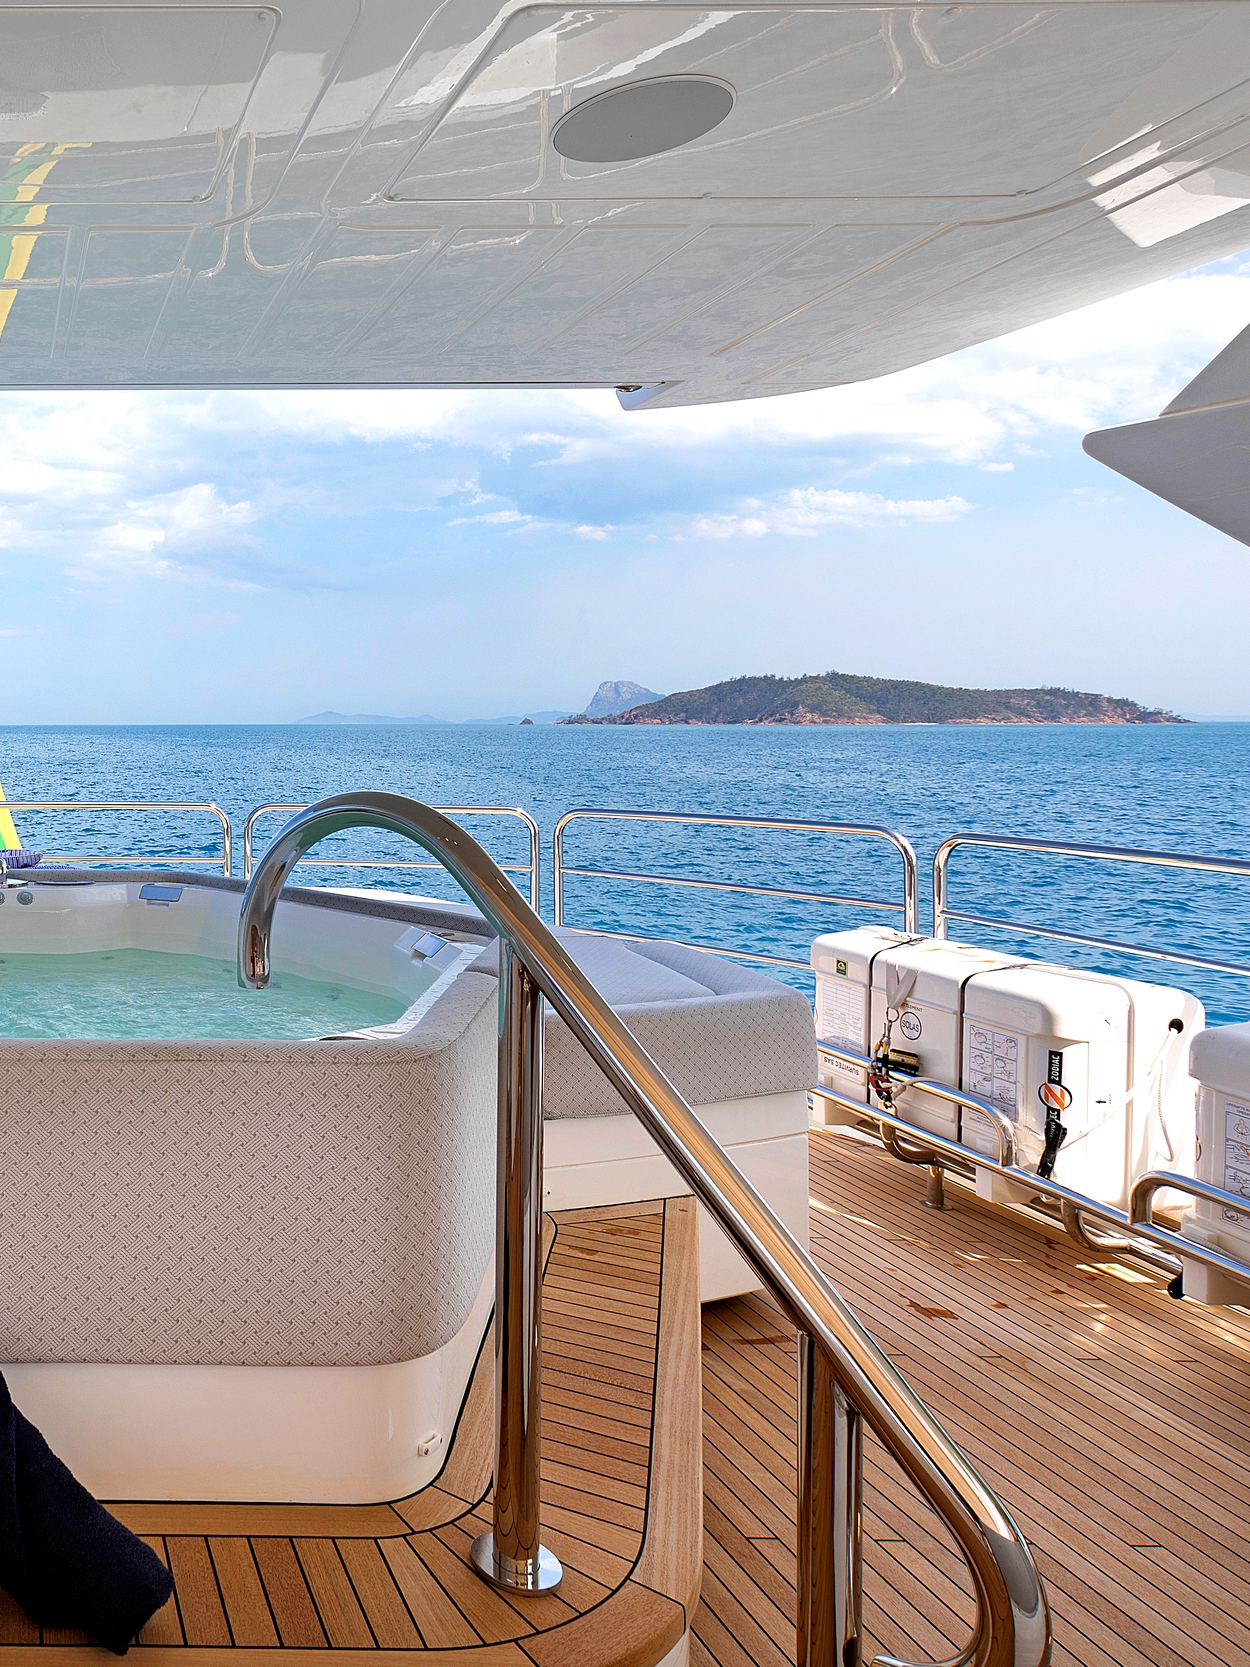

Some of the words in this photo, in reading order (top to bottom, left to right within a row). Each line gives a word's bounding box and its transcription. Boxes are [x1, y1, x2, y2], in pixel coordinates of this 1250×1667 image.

[901, 1019, 920, 1033] SOLAS
[823, 1056, 834, 1066] SAS
[834, 1060, 860, 1076] SURVITEC
[1050, 1054, 1060, 1081] ZODIAC
